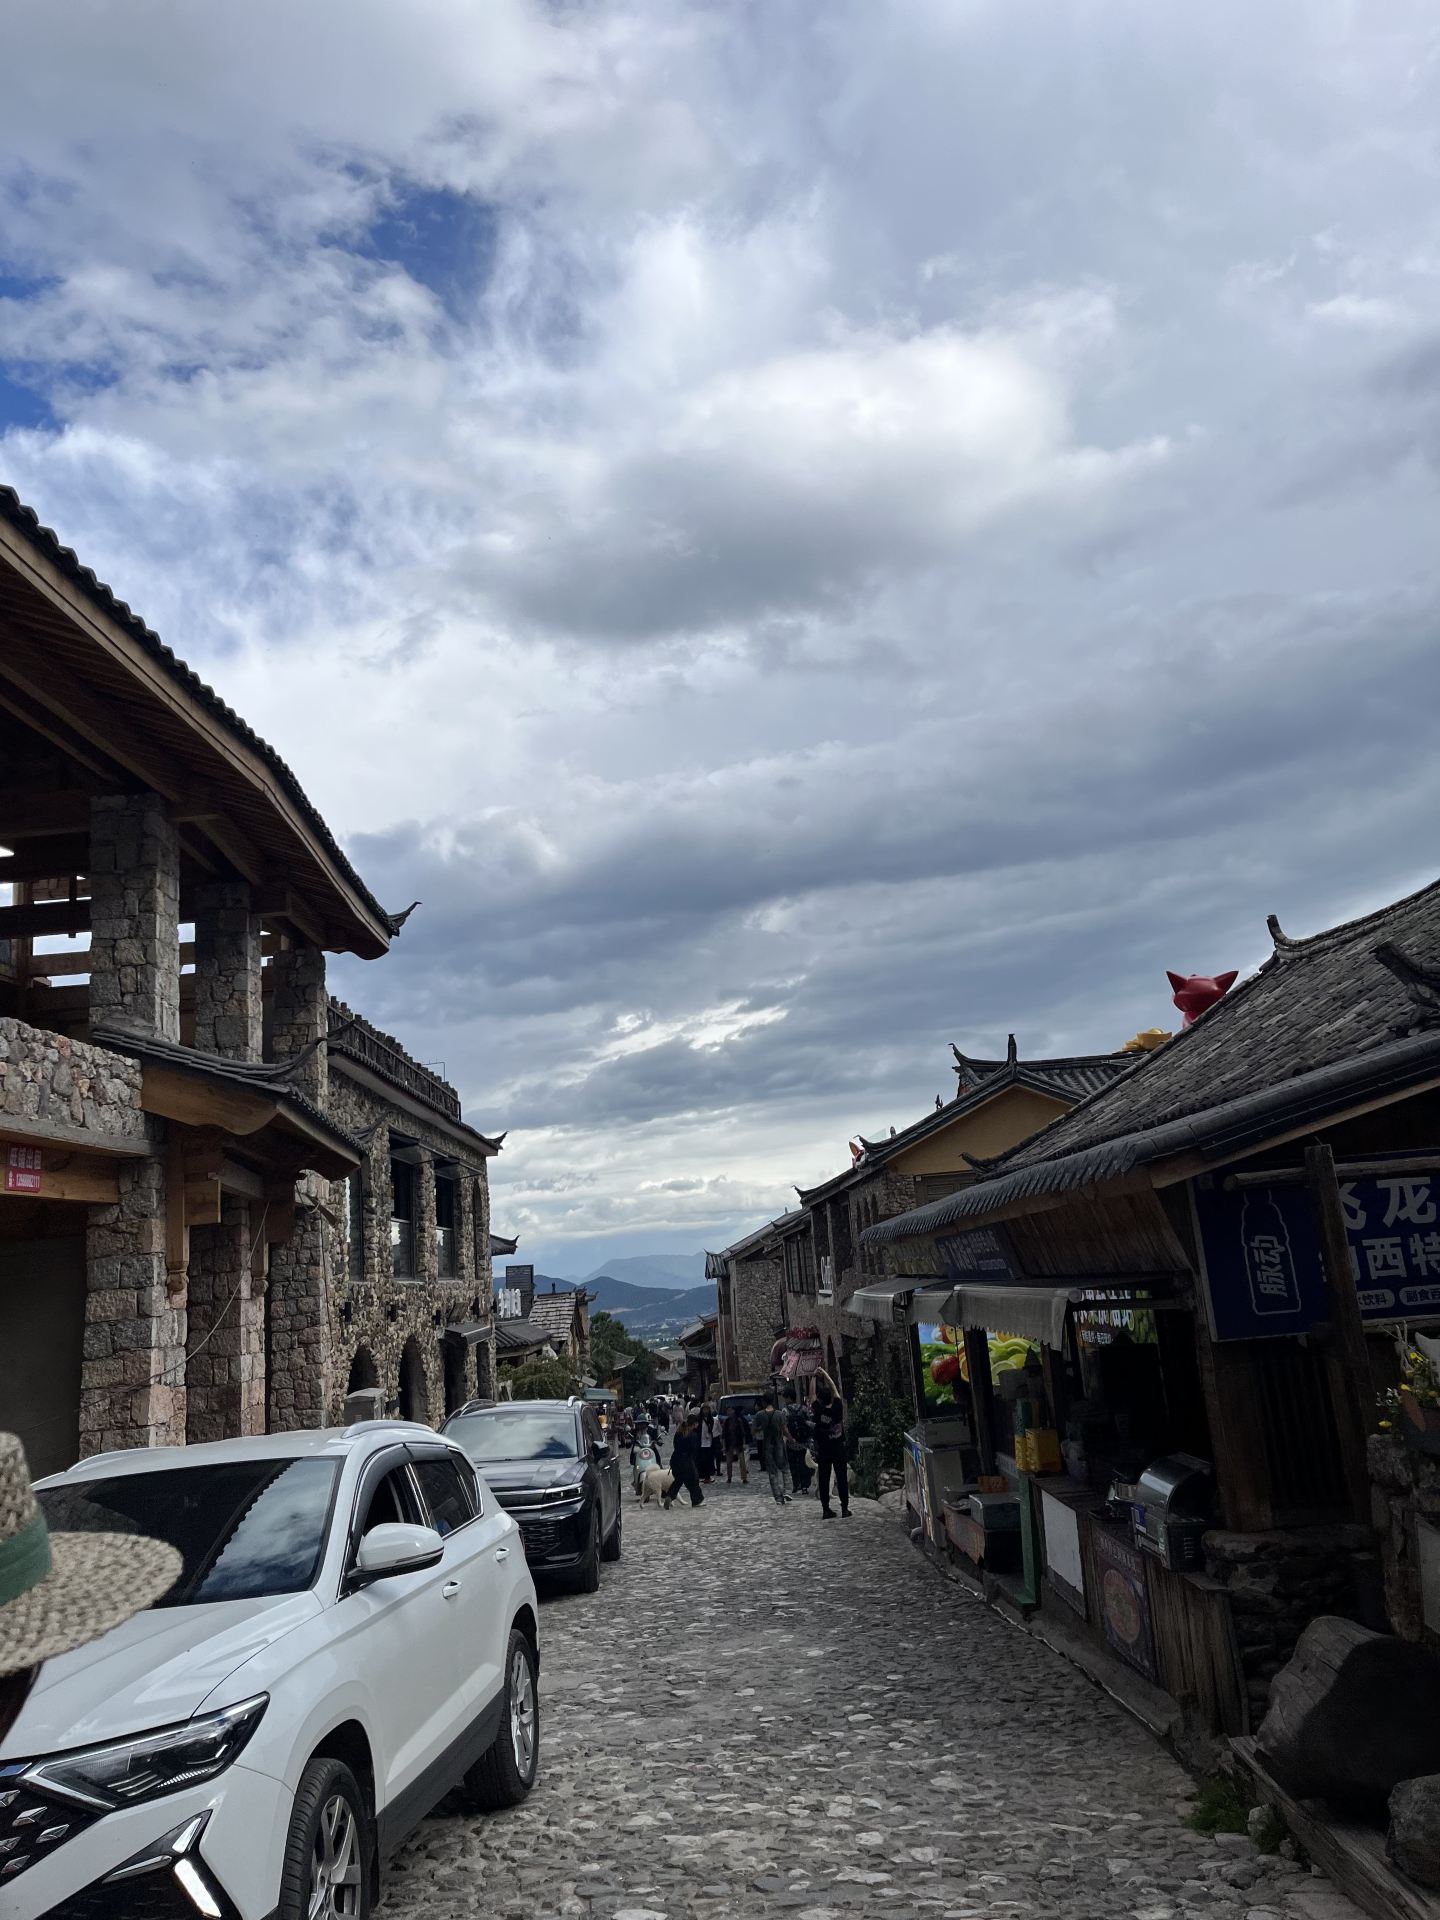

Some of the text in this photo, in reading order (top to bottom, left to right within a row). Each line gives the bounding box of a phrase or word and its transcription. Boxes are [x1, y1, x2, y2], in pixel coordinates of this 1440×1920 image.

[1250, 1235, 1287, 1297] 脉动
[1318, 1232, 1440, 1282] 西特
[1358, 1293, 1387, 1305] 饮料
